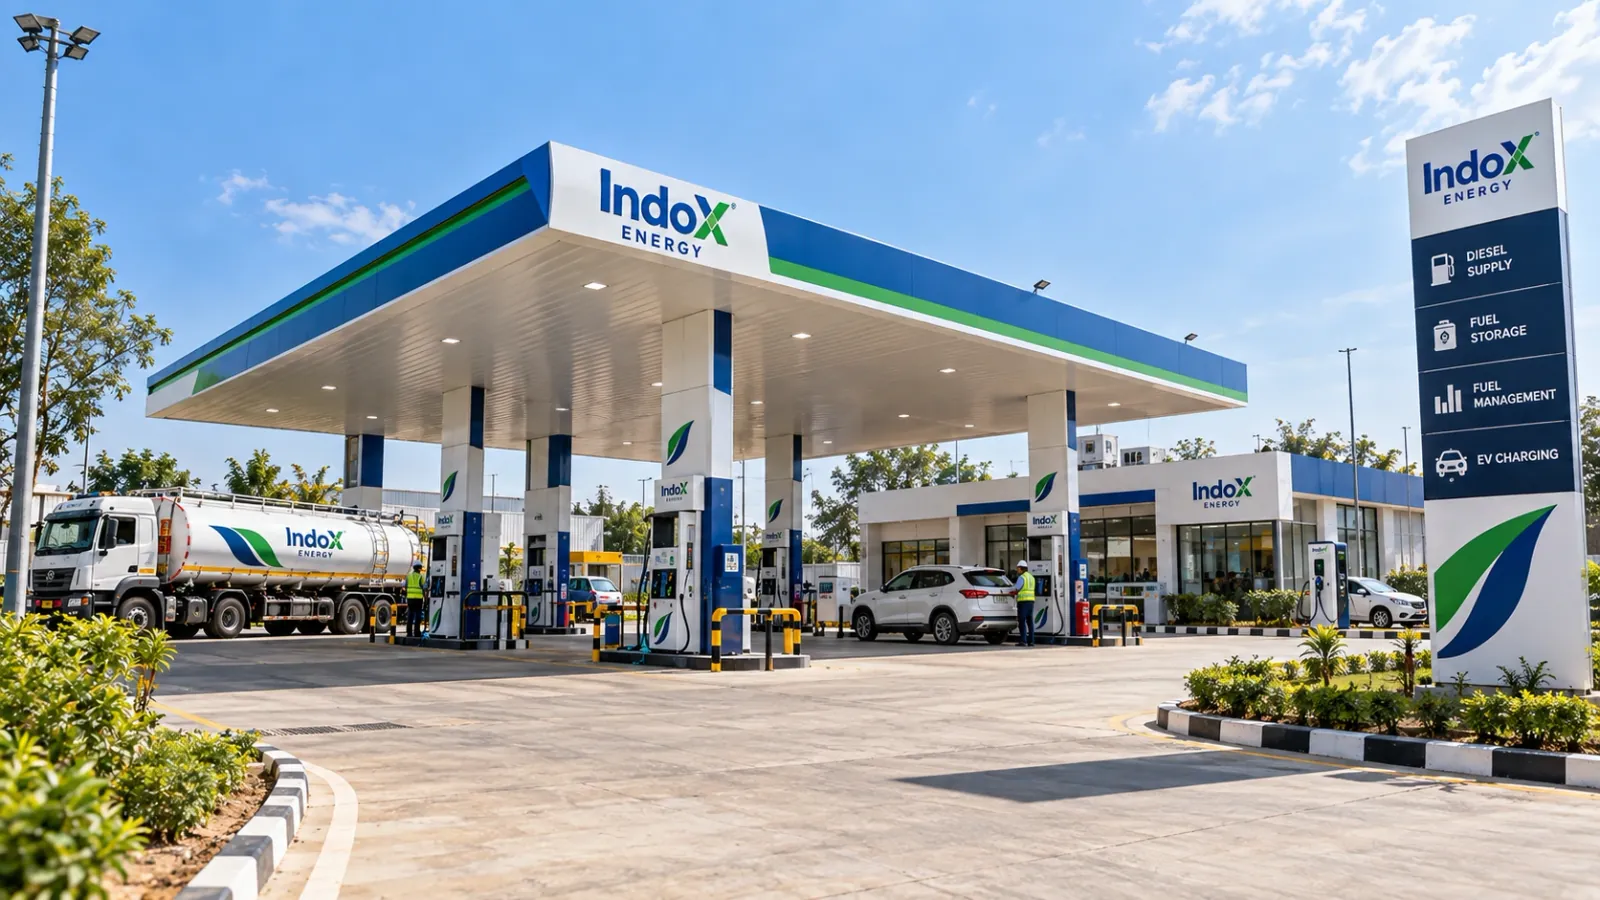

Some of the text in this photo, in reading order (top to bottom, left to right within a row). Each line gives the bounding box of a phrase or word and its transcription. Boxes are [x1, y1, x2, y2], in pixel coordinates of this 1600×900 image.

[1423, 134, 1534, 194] IndoX
[1443, 179, 1512, 205] ENERGY
[600, 168, 730, 247] IndoX
[621, 225, 702, 258] ENERGY
[1466, 244, 1507, 262] DIESEL
[1467, 258, 1512, 277] SUPPLY
[1470, 313, 1499, 328] FUEL
[1470, 324, 1527, 343] STORAGE
[1473, 380, 1502, 393] FUEL
[1474, 388, 1556, 408] MANAGEMENT
[1477, 448, 1559, 465] EV CHARGING
[661, 481, 688, 497] IndoX
[1192, 476, 1253, 501] IndoX
[1203, 499, 1240, 509] ENERGY
[285, 526, 344, 551] IndoX
[297, 549, 333, 559] ENERGY
